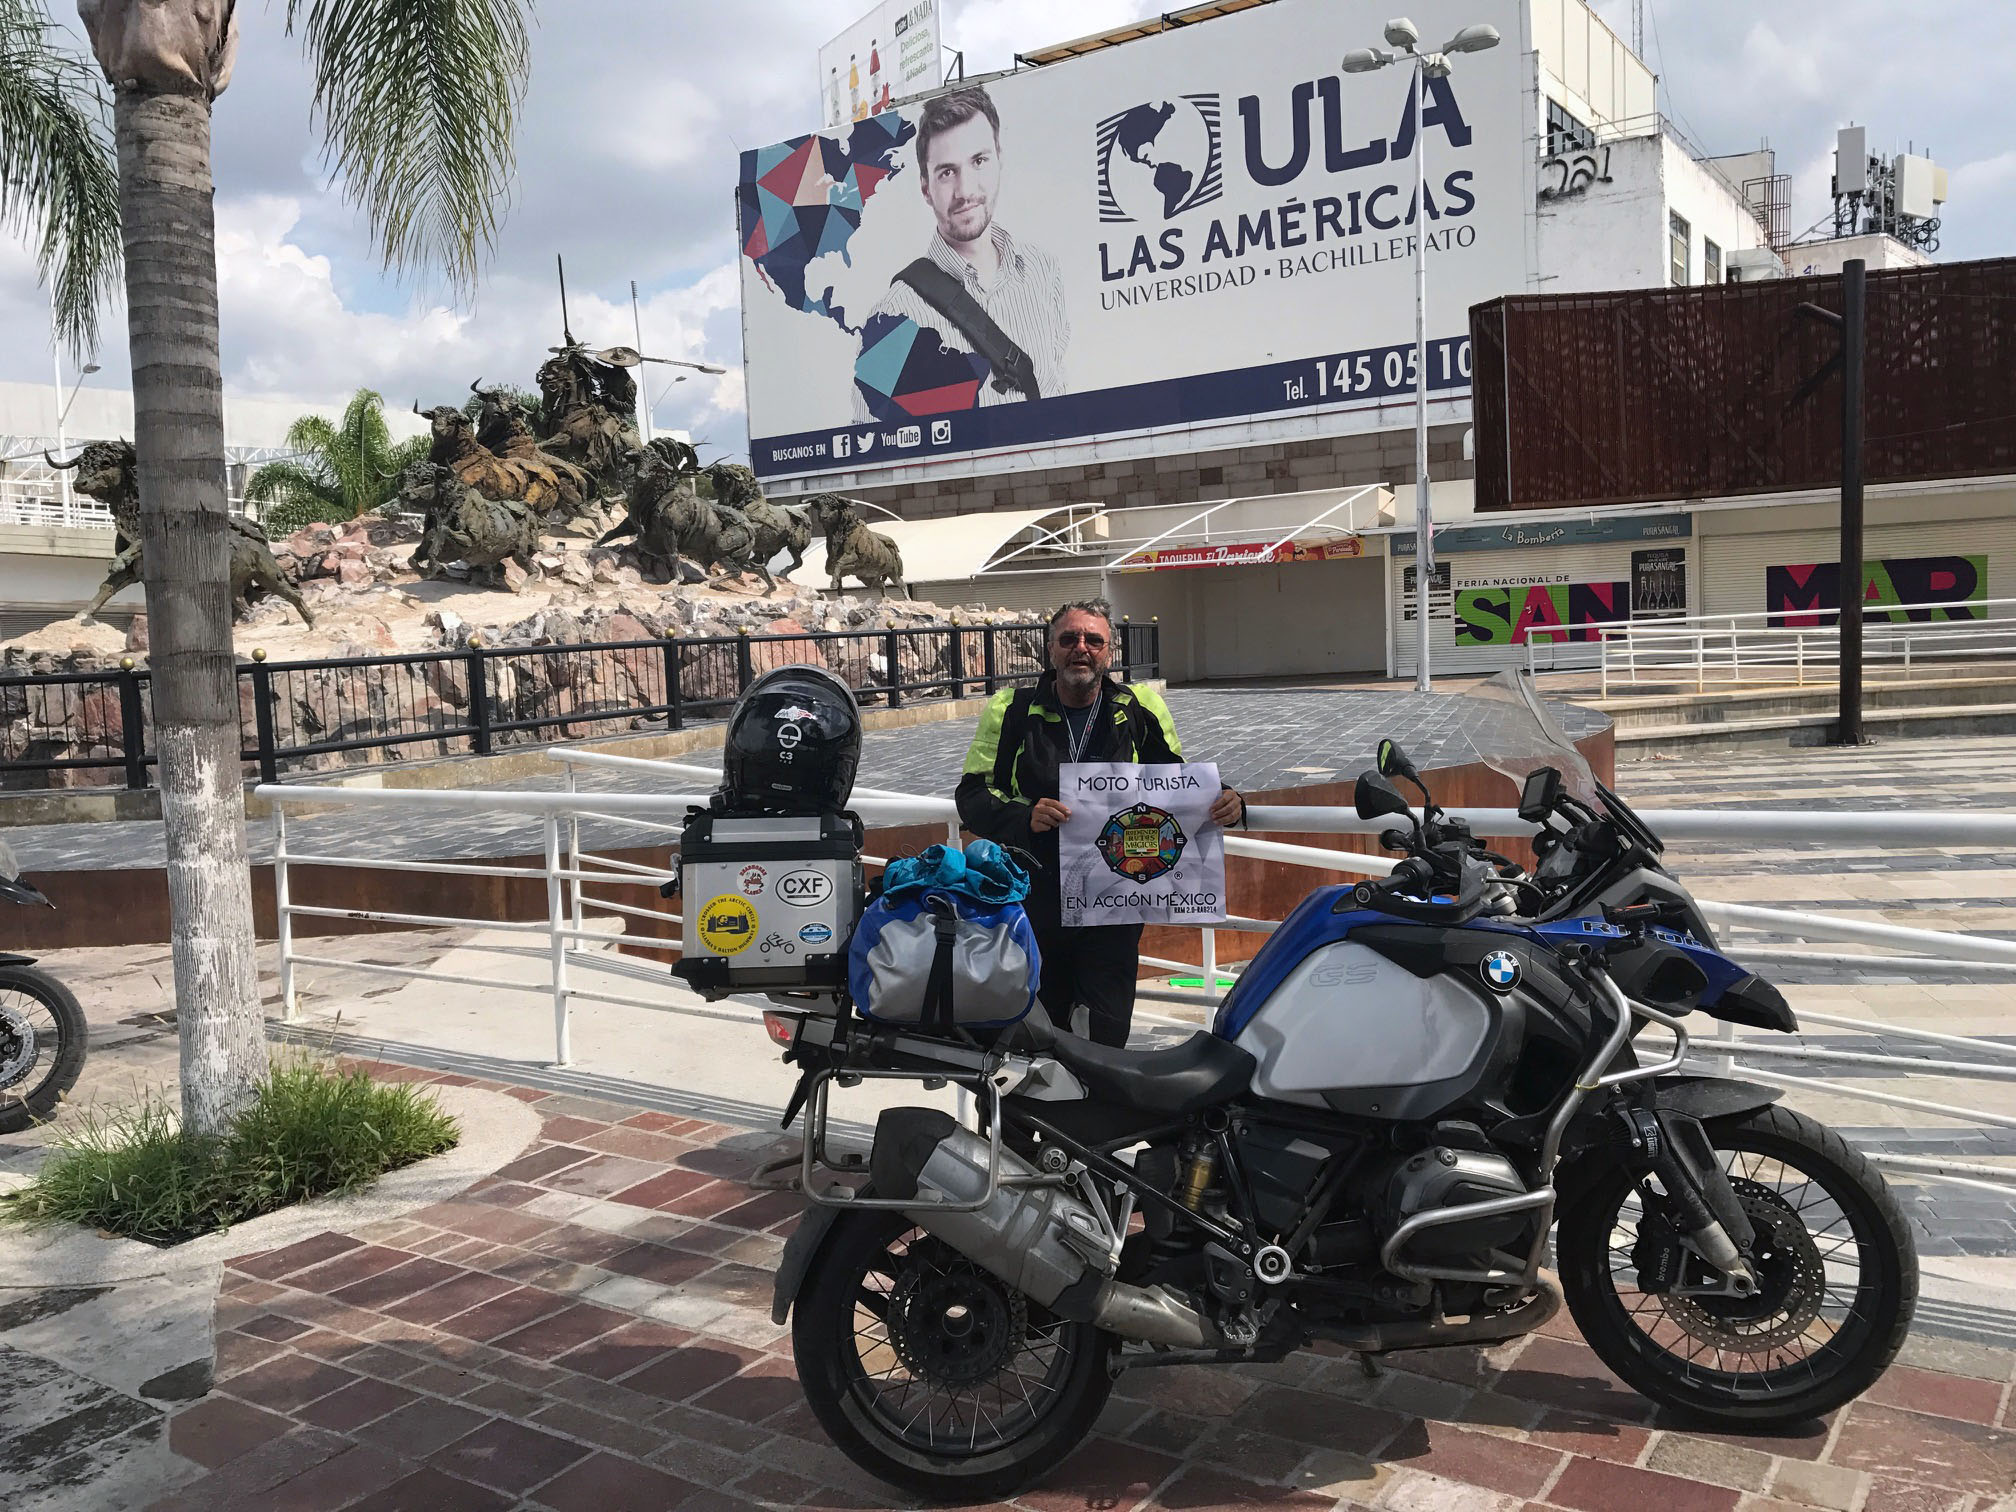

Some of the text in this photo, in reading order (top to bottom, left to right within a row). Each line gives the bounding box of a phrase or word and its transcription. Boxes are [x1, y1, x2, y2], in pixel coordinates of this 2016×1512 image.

[1238, 71, 1472, 187] ULA
[1099, 228, 1185, 282] LAS
[1201, 170, 1476, 263] AMÉRICAS
[1100, 224, 1476, 311] UNIVERSIDAD BACHILLERATO
[1283, 376, 1308, 401] Tel.
[1316, 355, 1372, 396] 145
[1383, 349, 1418, 388] 05
[772, 444, 814, 462] BUSCANOS
[816, 443, 826, 456] EN
[881, 427, 920, 448] YouTube
[1501, 526, 1513, 541] La
[1517, 527, 1565, 545] Bombería
[1457, 575, 1570, 588] FERIA NACIONAL DE
[1766, 556, 1979, 627] MAR
[1455, 582, 1629, 646] SAN
[779, 751, 793, 760] C3
[1078, 776, 1200, 792] MOTO TURISTA
[783, 878, 823, 894] CXF
[729, 897, 746, 908] ARCTIC
[1066, 891, 1217, 909] EN ACCIÓN MÉXICO
[1485, 951, 1520, 967] BMW
[1655, 1247, 1670, 1282] brembo
